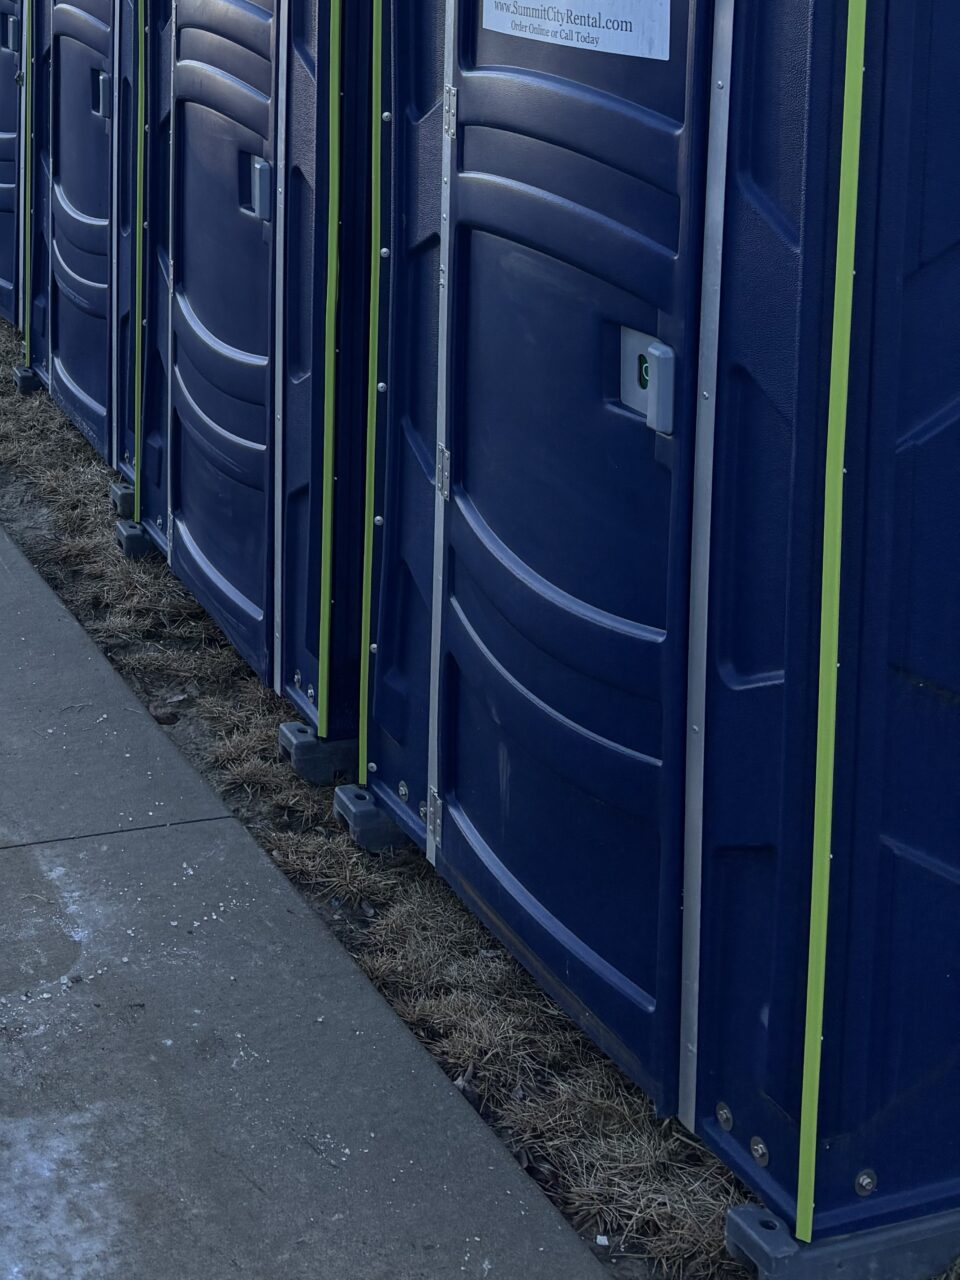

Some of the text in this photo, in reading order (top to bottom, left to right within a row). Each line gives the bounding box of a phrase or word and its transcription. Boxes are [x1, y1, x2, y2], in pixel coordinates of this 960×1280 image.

[494, 0, 633, 33] www.SummitCityRental.com
[510, 20, 600, 47] Order Online or Call Today
